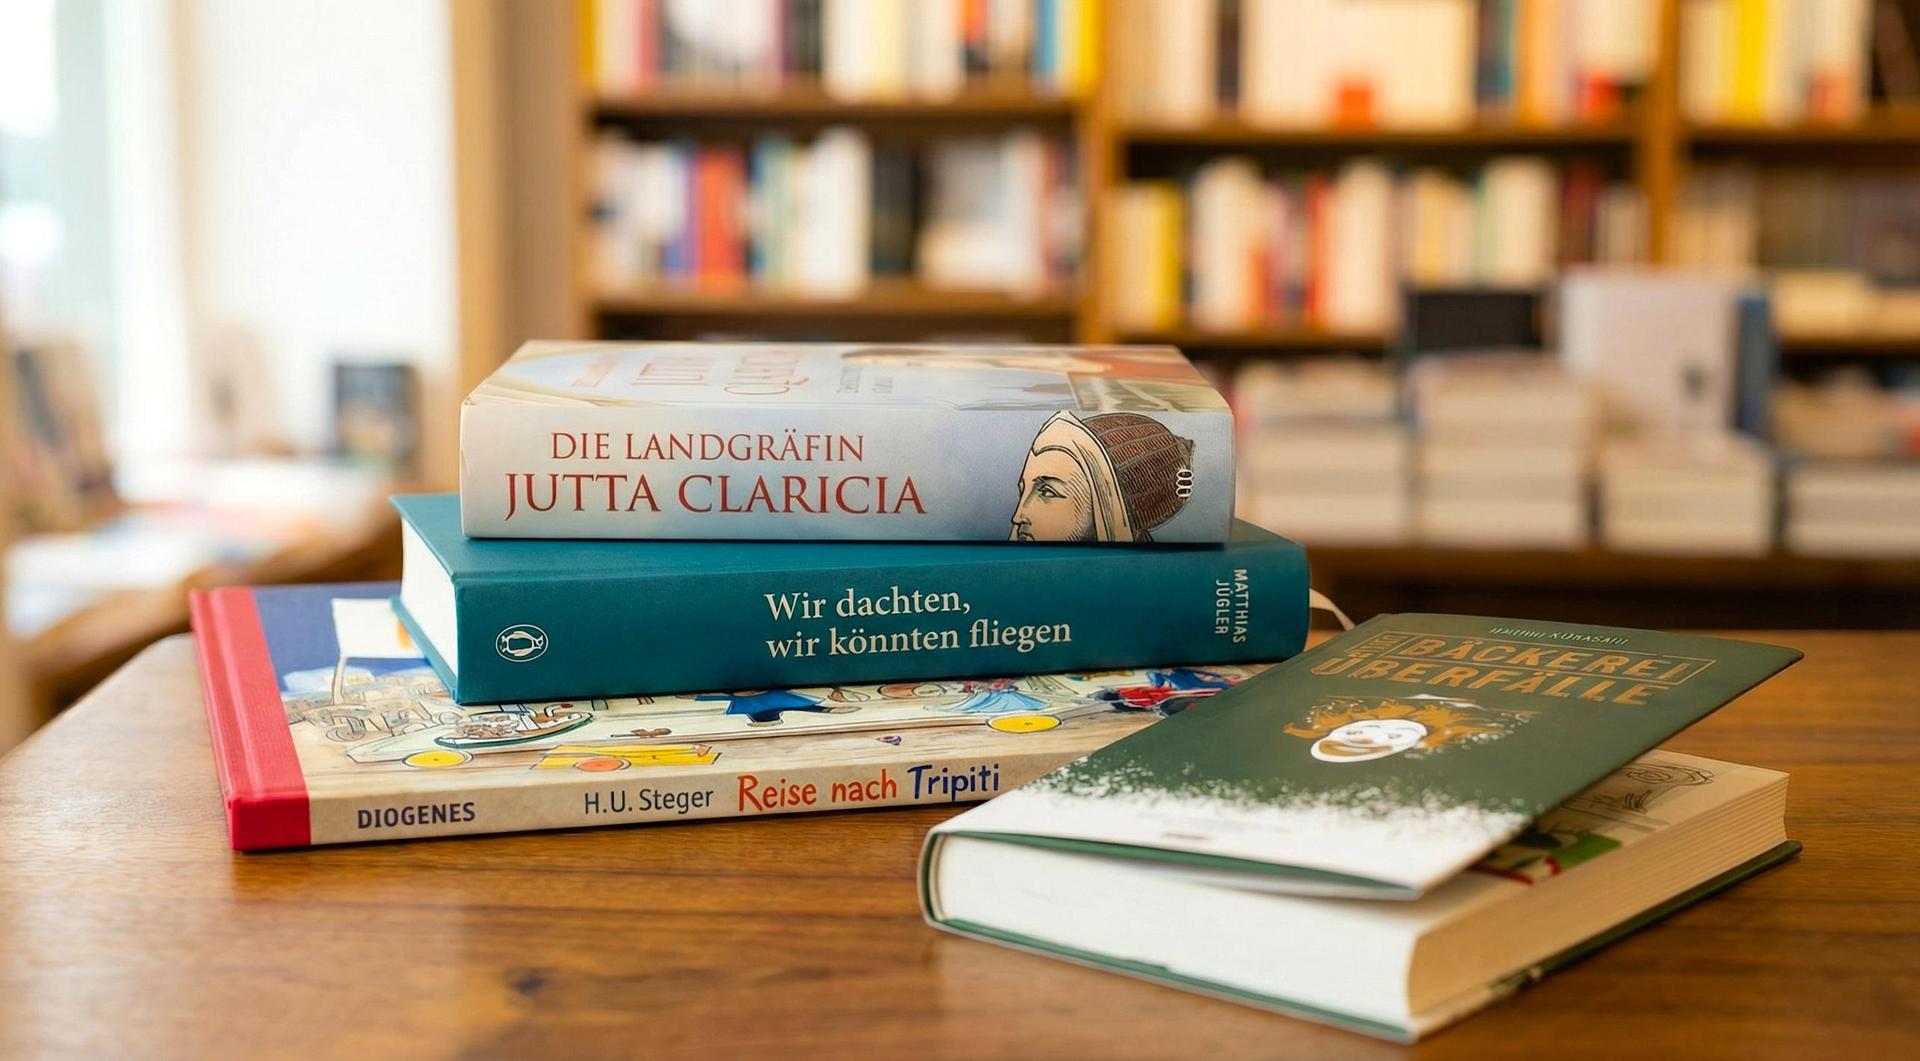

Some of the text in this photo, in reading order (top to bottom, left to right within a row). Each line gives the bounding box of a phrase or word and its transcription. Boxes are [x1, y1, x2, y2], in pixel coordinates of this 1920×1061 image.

[550, 428, 865, 461] DIE LANDGRÄFIN
[504, 473, 928, 521] JUTTA CLARICIA
[763, 585, 971, 621] Wir dachten,
[1214, 579, 1234, 635] JÜGLER
[1232, 568, 1249, 643] MATTHIAS
[765, 618, 1073, 659] wir könnten fliegen
[1399, 638, 1691, 681] BÄCKEREI
[1310, 651, 1670, 706] ÜBERFÄLLE
[583, 788, 714, 815] H.U. Steger
[737, 763, 1001, 813] Reise nach Tripiti
[357, 802, 477, 829] DIOGENES
